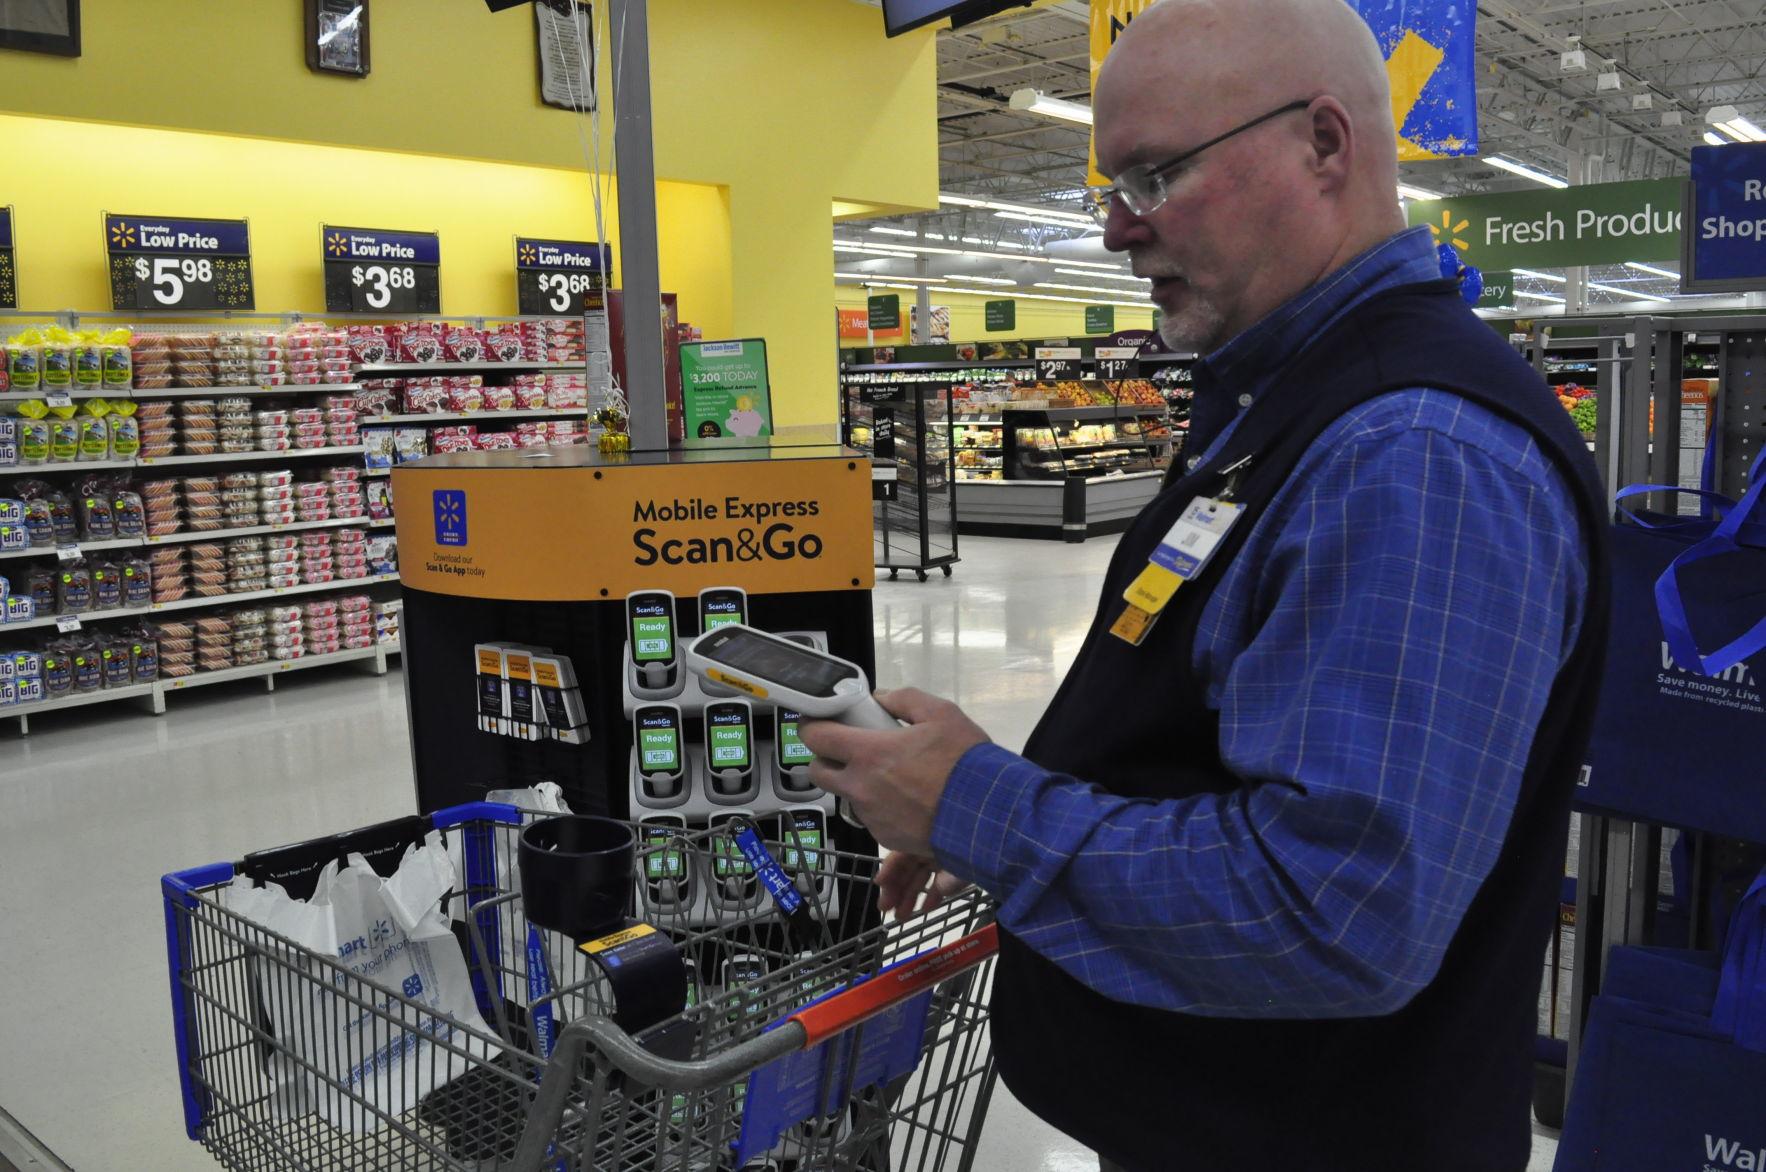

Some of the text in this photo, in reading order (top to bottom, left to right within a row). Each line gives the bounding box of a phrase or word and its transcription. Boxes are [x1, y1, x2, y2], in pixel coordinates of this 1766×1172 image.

[1745, 179, 1766, 201] R
[140, 225, 170, 234] Everyday
[1486, 203, 1681, 245] Fresh Produ
[140, 231, 218, 249] Low Price
[351, 235, 375, 244] Everyday
[351, 242, 415, 258] Low Price
[539, 252, 591, 267] Low Price
[851, 318, 869, 328] Mea
[722, 371, 758, 381] TODAY
[633, 496, 819, 525] Mobile Express
[633, 523, 823, 566] Scan&Go
[433, 552, 461, 563] Download
[426, 562, 438, 571] Scan
[444, 564, 452, 573] Go
[453, 565, 466, 576] App
[467, 567, 486, 578] today
[708, 602, 736, 610] Scan&Go
[639, 623, 666, 632] Ready
[1657, 673, 1761, 702] Save money. Live
[646, 734, 672, 744] Ready
[716, 731, 742, 740] Ready
[536, 1015, 549, 1060] Walma
